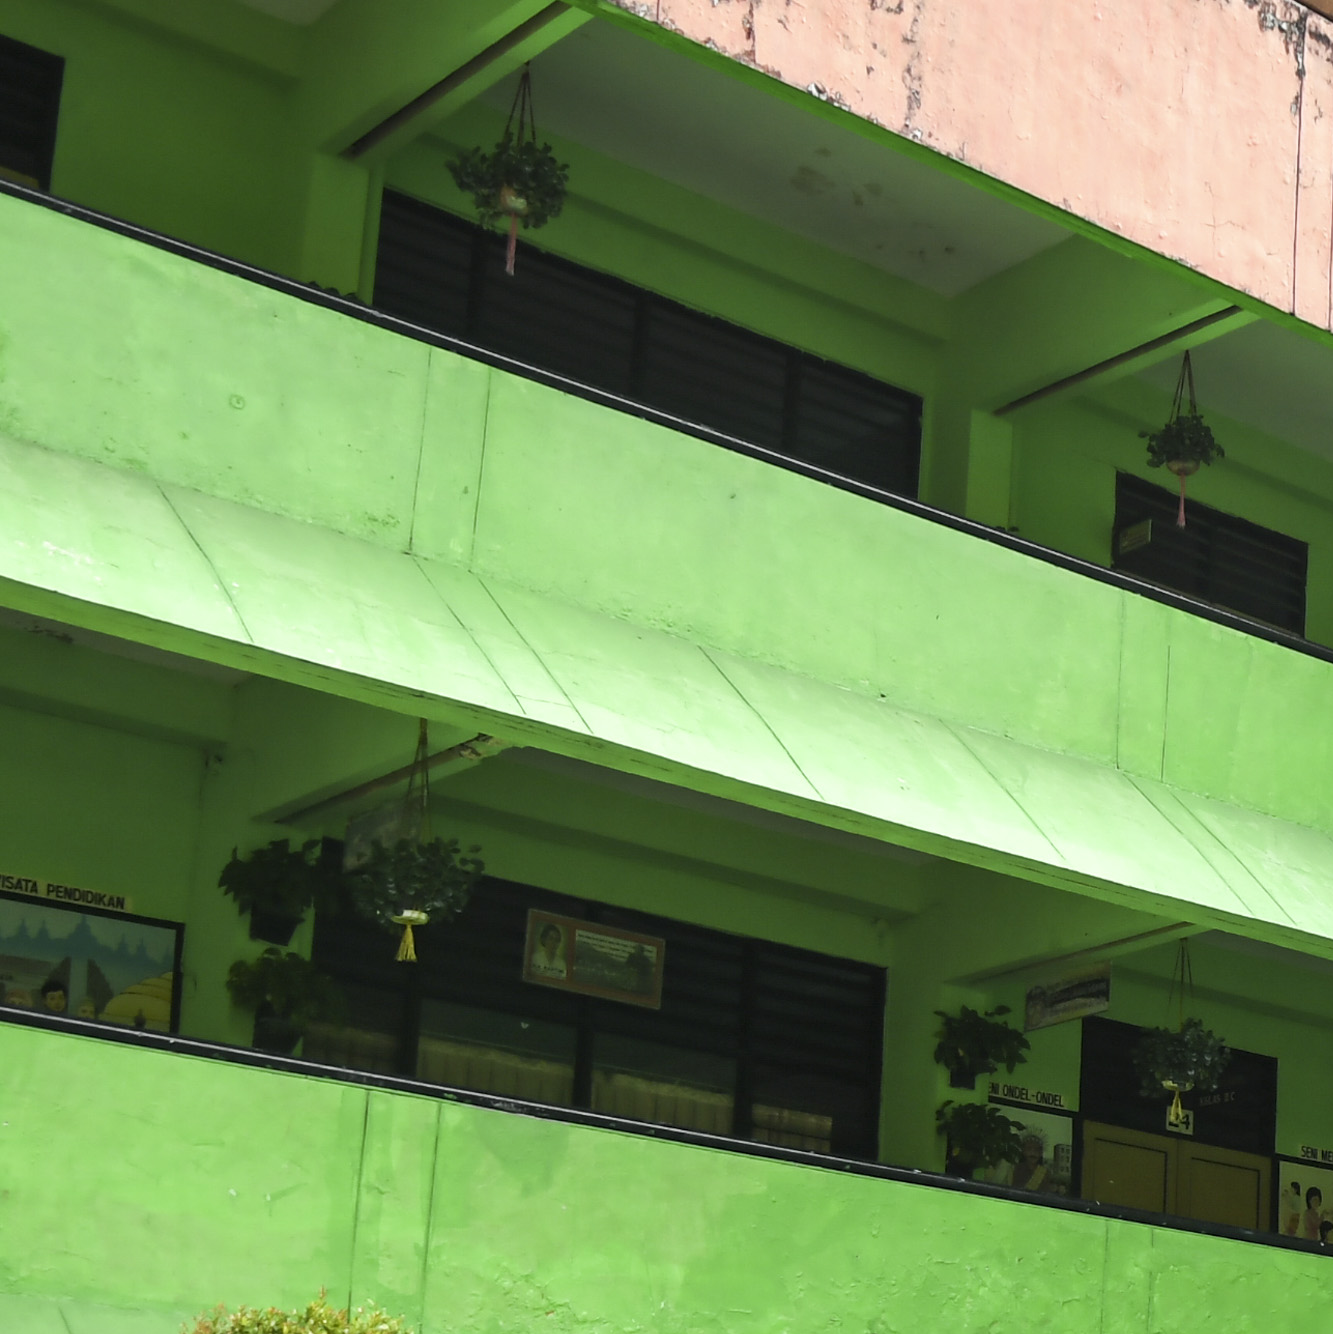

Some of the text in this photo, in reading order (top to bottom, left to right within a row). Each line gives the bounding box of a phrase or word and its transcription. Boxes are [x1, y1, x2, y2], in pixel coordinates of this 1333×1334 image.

[0, 874, 125, 910] ISATA PENDIDIKAN
[1002, 1084, 1064, 1108] ONDEL-ONDEL
[1301, 1145, 1318, 1160] SENI
